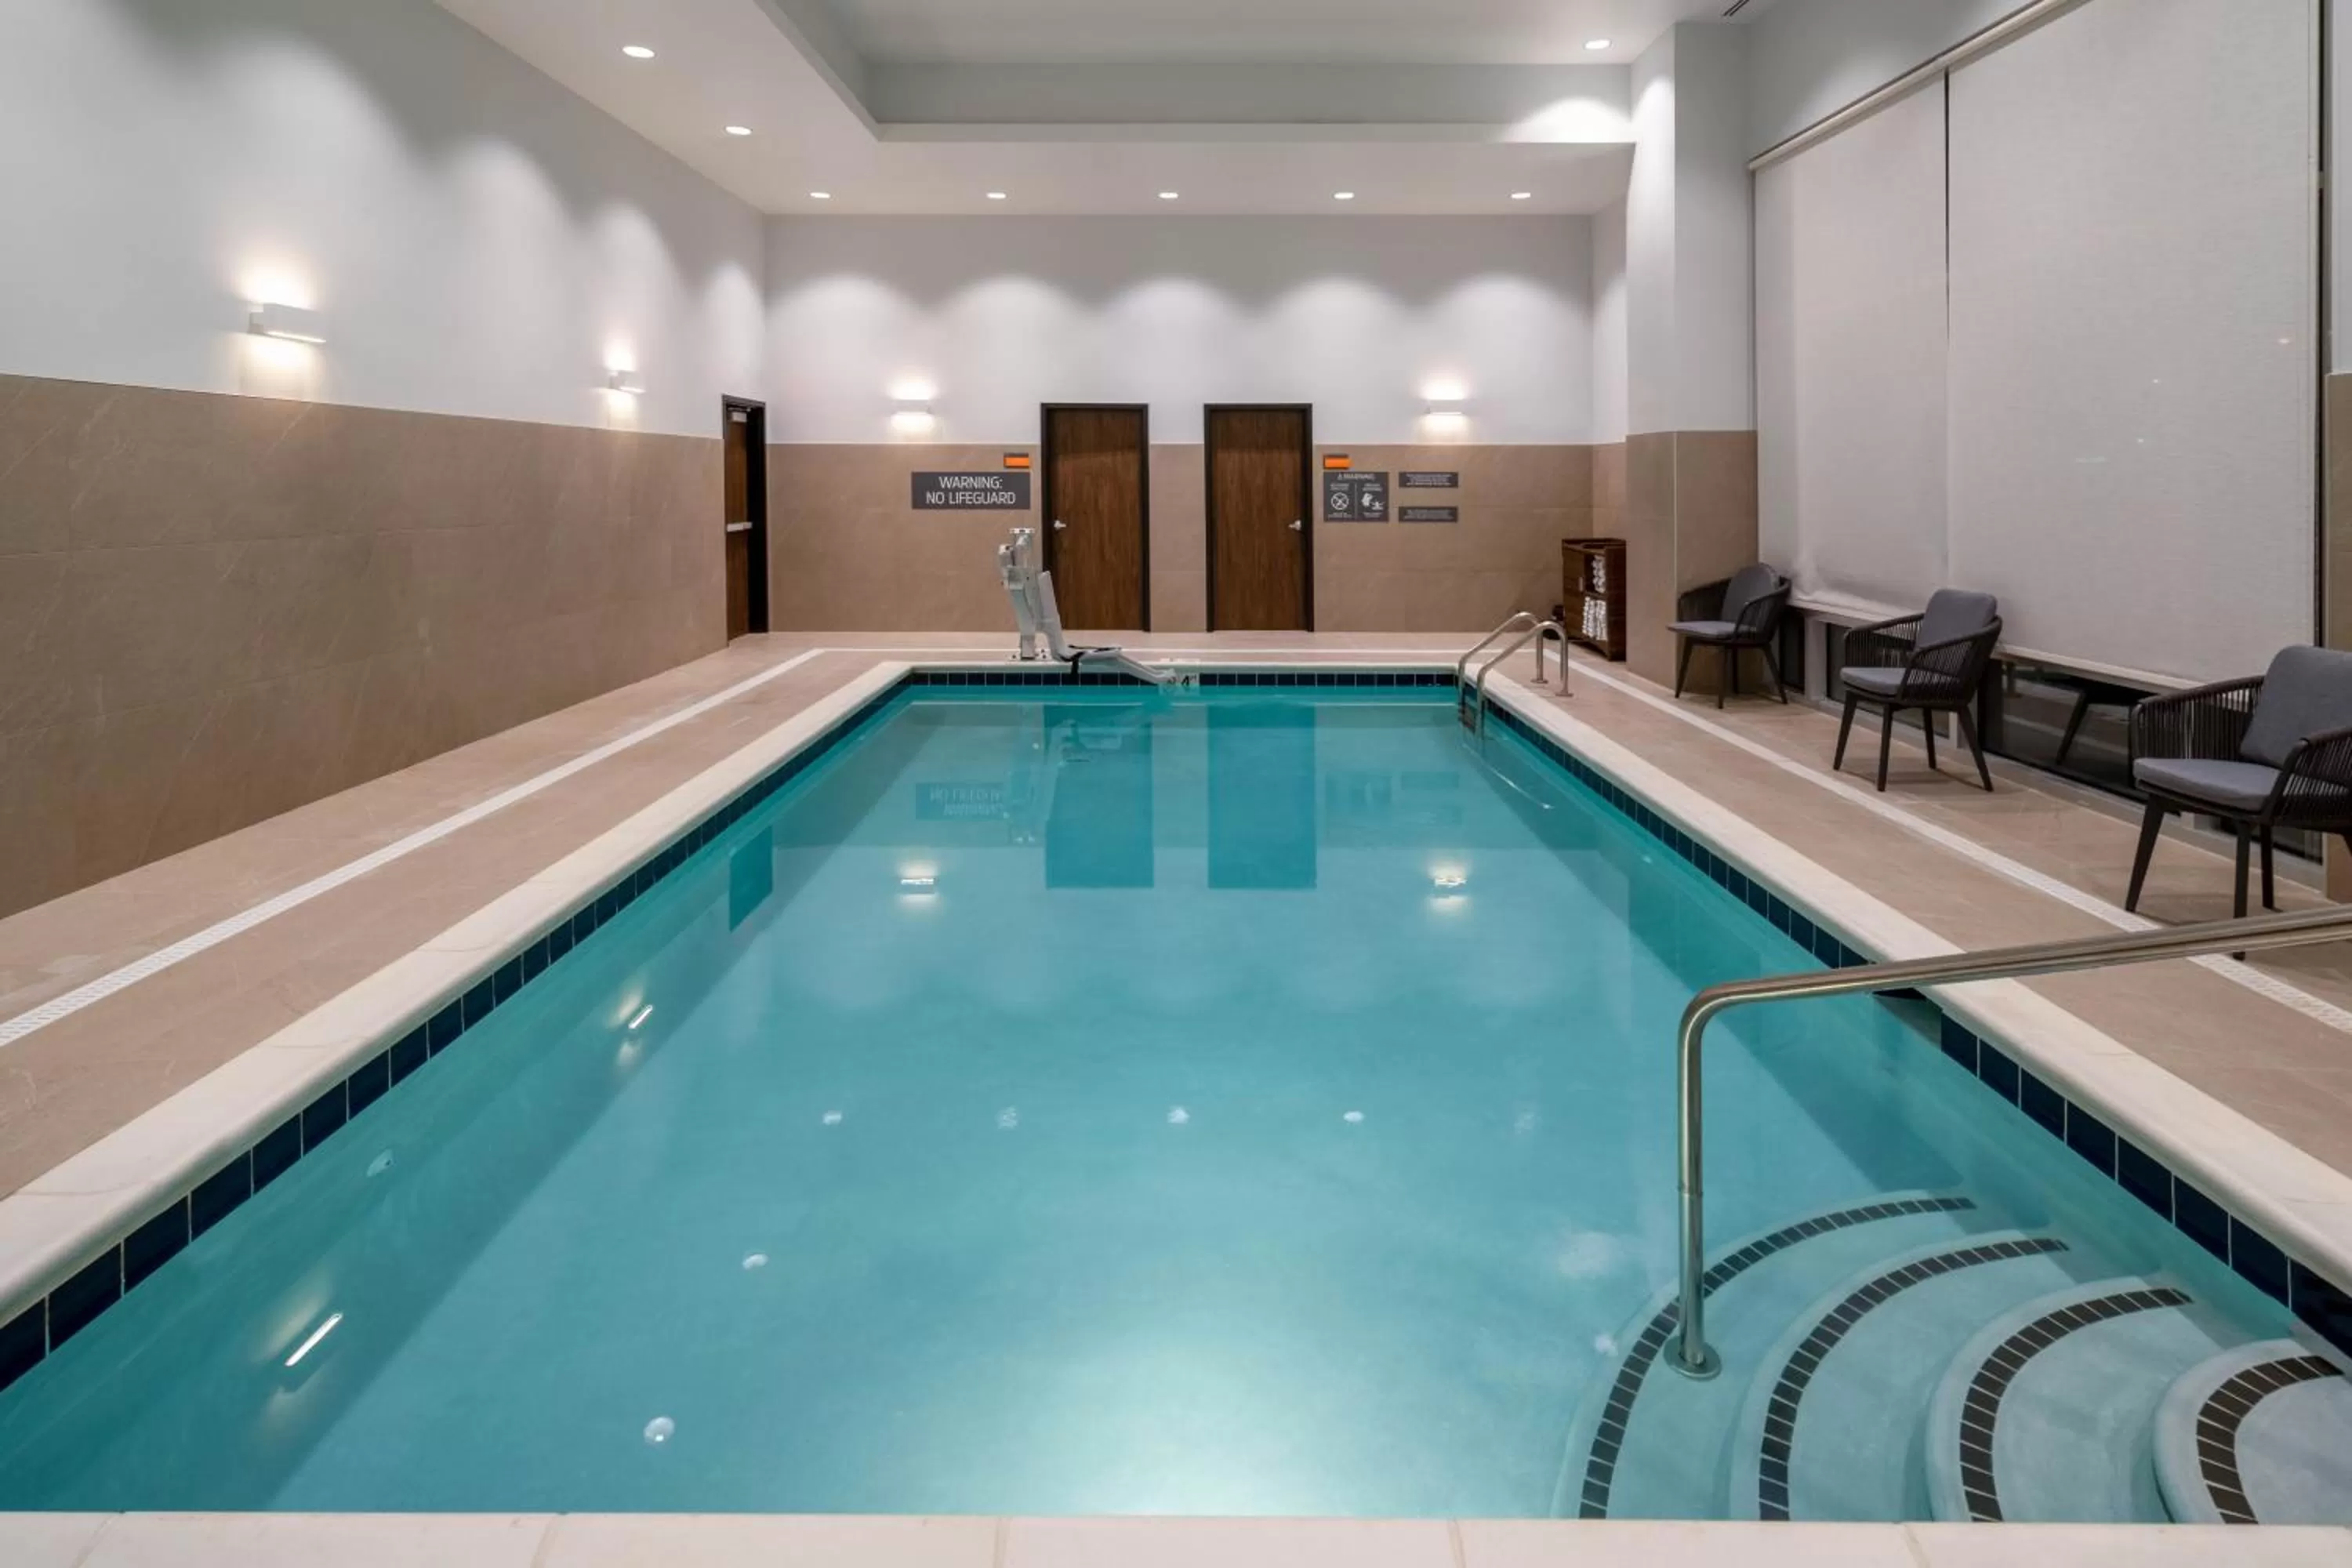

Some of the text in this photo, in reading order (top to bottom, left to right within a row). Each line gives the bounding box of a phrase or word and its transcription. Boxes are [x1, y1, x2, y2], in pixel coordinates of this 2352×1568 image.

[938, 476, 1004, 488] WARNING:
[926, 492, 1016, 504] NO LIFEGUARD
